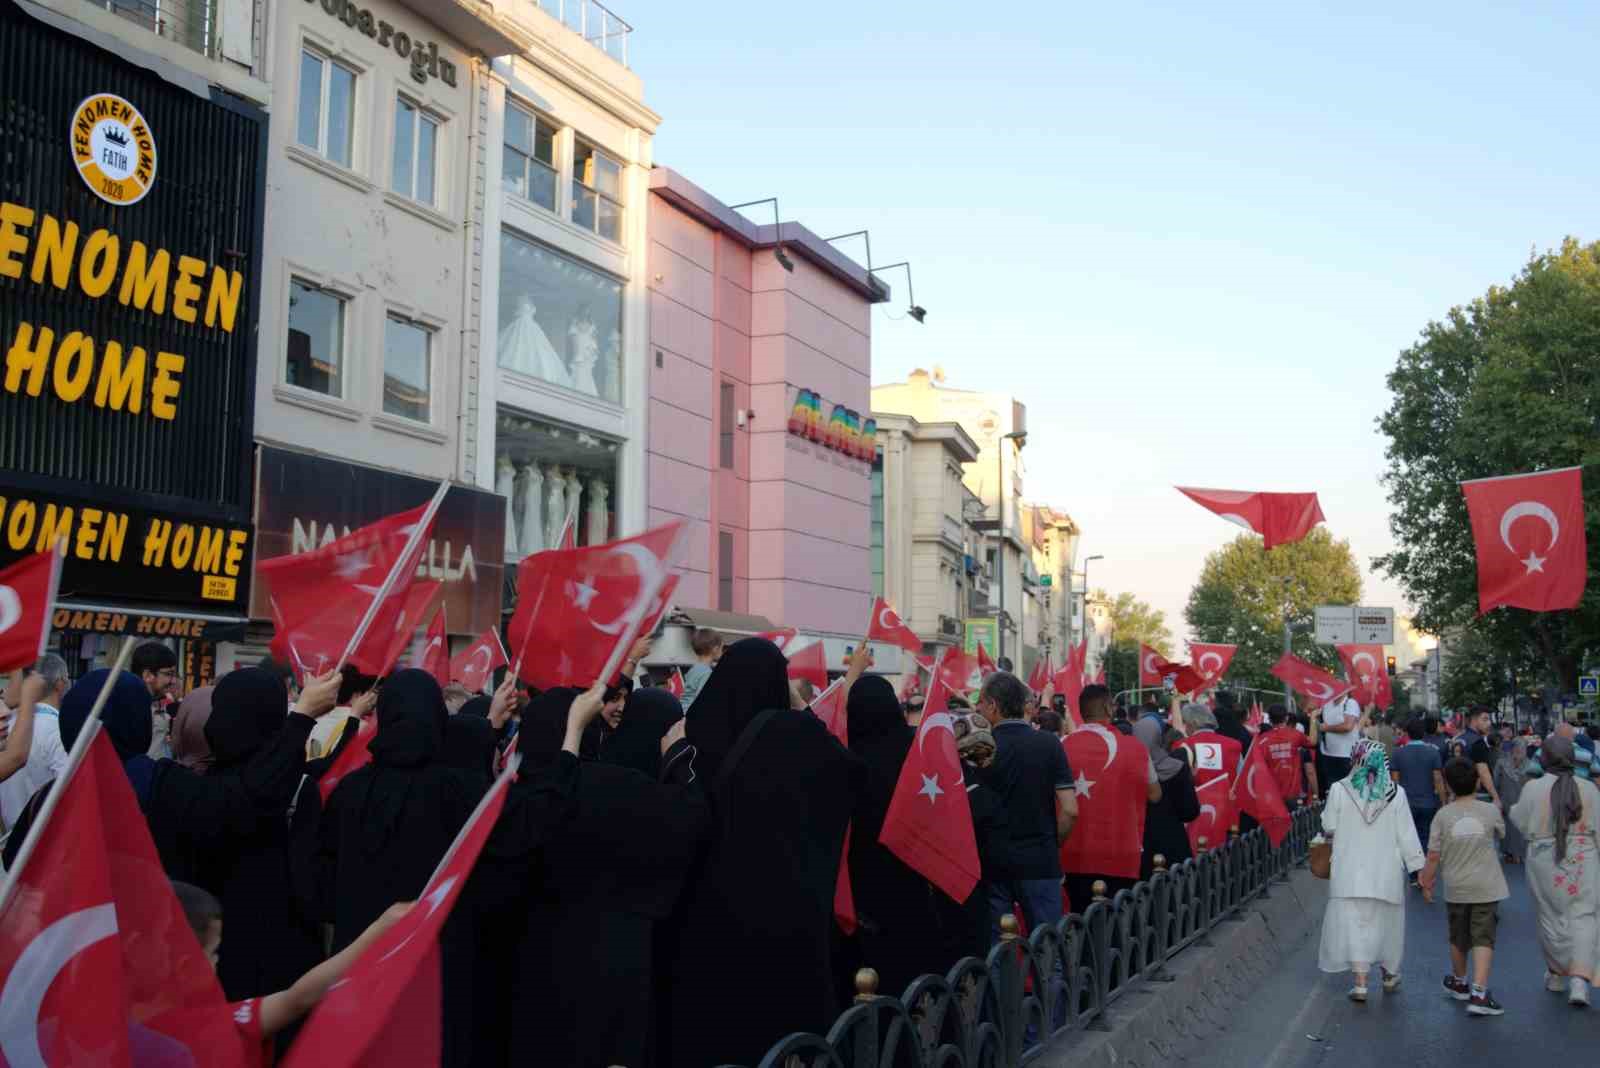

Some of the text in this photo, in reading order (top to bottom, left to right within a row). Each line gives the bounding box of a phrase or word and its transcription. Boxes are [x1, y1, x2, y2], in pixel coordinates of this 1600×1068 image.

[305, 0, 457, 88] obaroğlu
[75, 100, 151, 185] FENOMEN HOME
[4, 321, 185, 420] HOME
[0, 497, 248, 577] OMEN HOME
[136, 615, 209, 637] HOME
